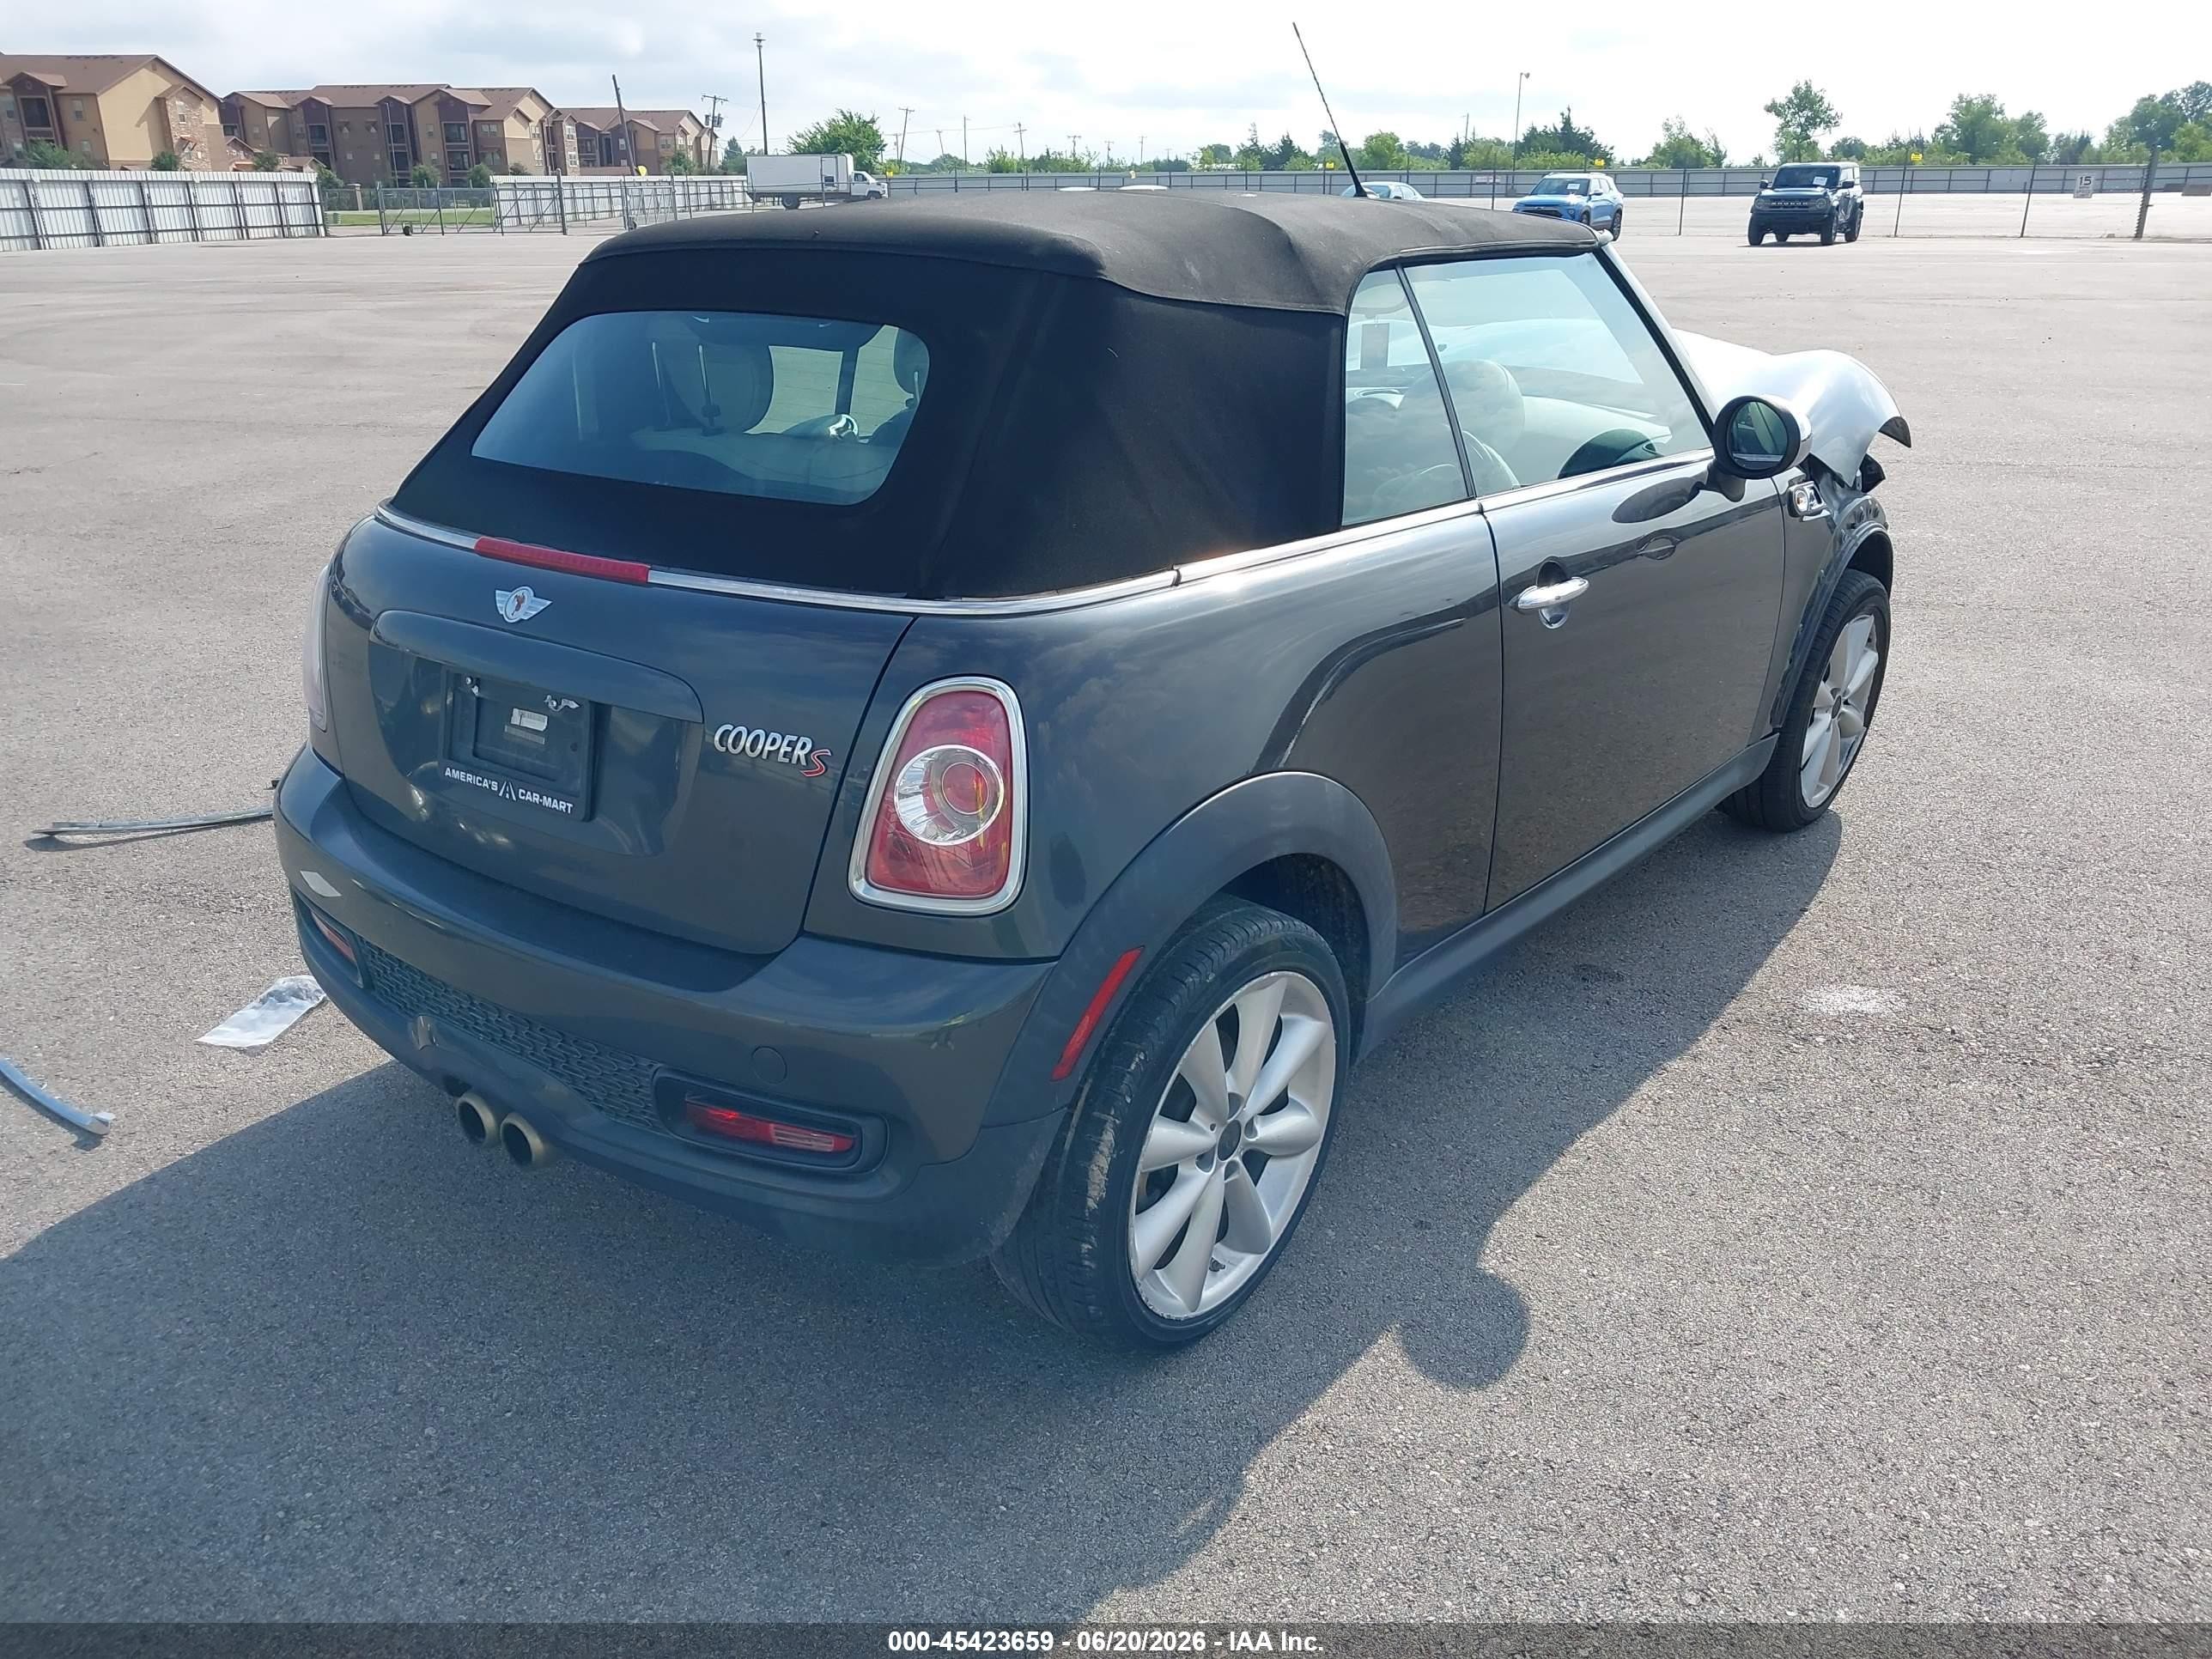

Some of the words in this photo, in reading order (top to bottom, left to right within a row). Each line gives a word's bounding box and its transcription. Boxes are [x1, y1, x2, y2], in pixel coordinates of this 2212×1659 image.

[2080, 176, 2092, 185] 15
[714, 724, 812, 766] COOPER
[445, 767, 498, 792] AMERICA'S
[518, 788, 574, 814] CAR-MART
